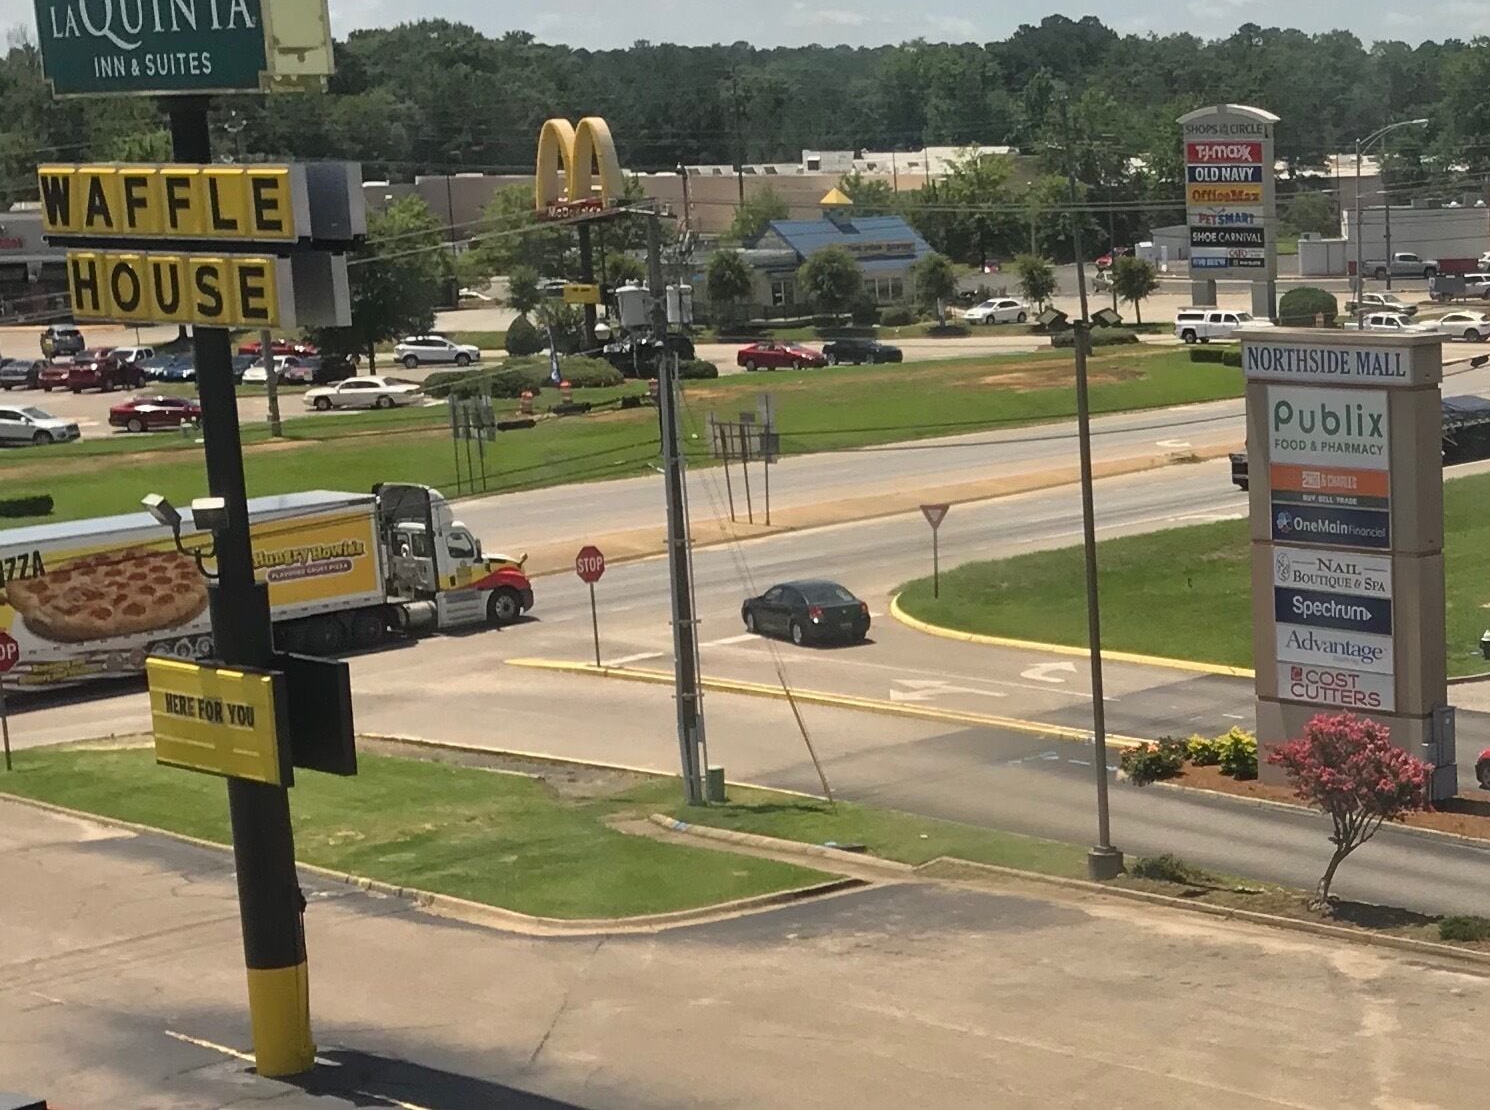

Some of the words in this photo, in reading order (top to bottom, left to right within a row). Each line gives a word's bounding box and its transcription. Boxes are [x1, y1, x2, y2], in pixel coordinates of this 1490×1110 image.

[50, 5, 80, 39] LA
[94, 56, 126, 78] INN
[131, 59, 141, 77] &
[146, 52, 212, 76] SUITES
[1230, 123, 1263, 135] CIRCLE
[1195, 167, 1219, 181] OLD
[1221, 167, 1254, 181] NAVY
[41, 176, 283, 231] WAFFLE
[1192, 189, 1260, 203] OfficeMax
[1192, 232, 1217, 242] SHOE
[1218, 232, 1262, 243] CARNIVAL
[72, 259, 269, 319] HOUSE
[1247, 346, 1350, 375] NORTHSIDE
[1356, 351, 1406, 378] MALL
[1274, 400, 1384, 438] Publix
[1275, 438, 1306, 451] FOOD
[1310, 441, 1317, 451] &
[1321, 441, 1384, 456] PHARMACY
[577, 556, 603, 573] STOP
[1316, 557, 1362, 576] NAIL
[1293, 569, 1351, 589] BOUTIQUE
[1354, 579, 1362, 589] &
[1364, 577, 1386, 592] SPA
[1292, 595, 1367, 621] Spectrum
[1286, 630, 1384, 665] Advantage
[1305, 669, 1360, 689] COST
[1290, 682, 1381, 708] CUTTERS
[165, 693, 196, 717] HERE
[198, 698, 224, 723] FOR
[227, 703, 255, 727] YOU
